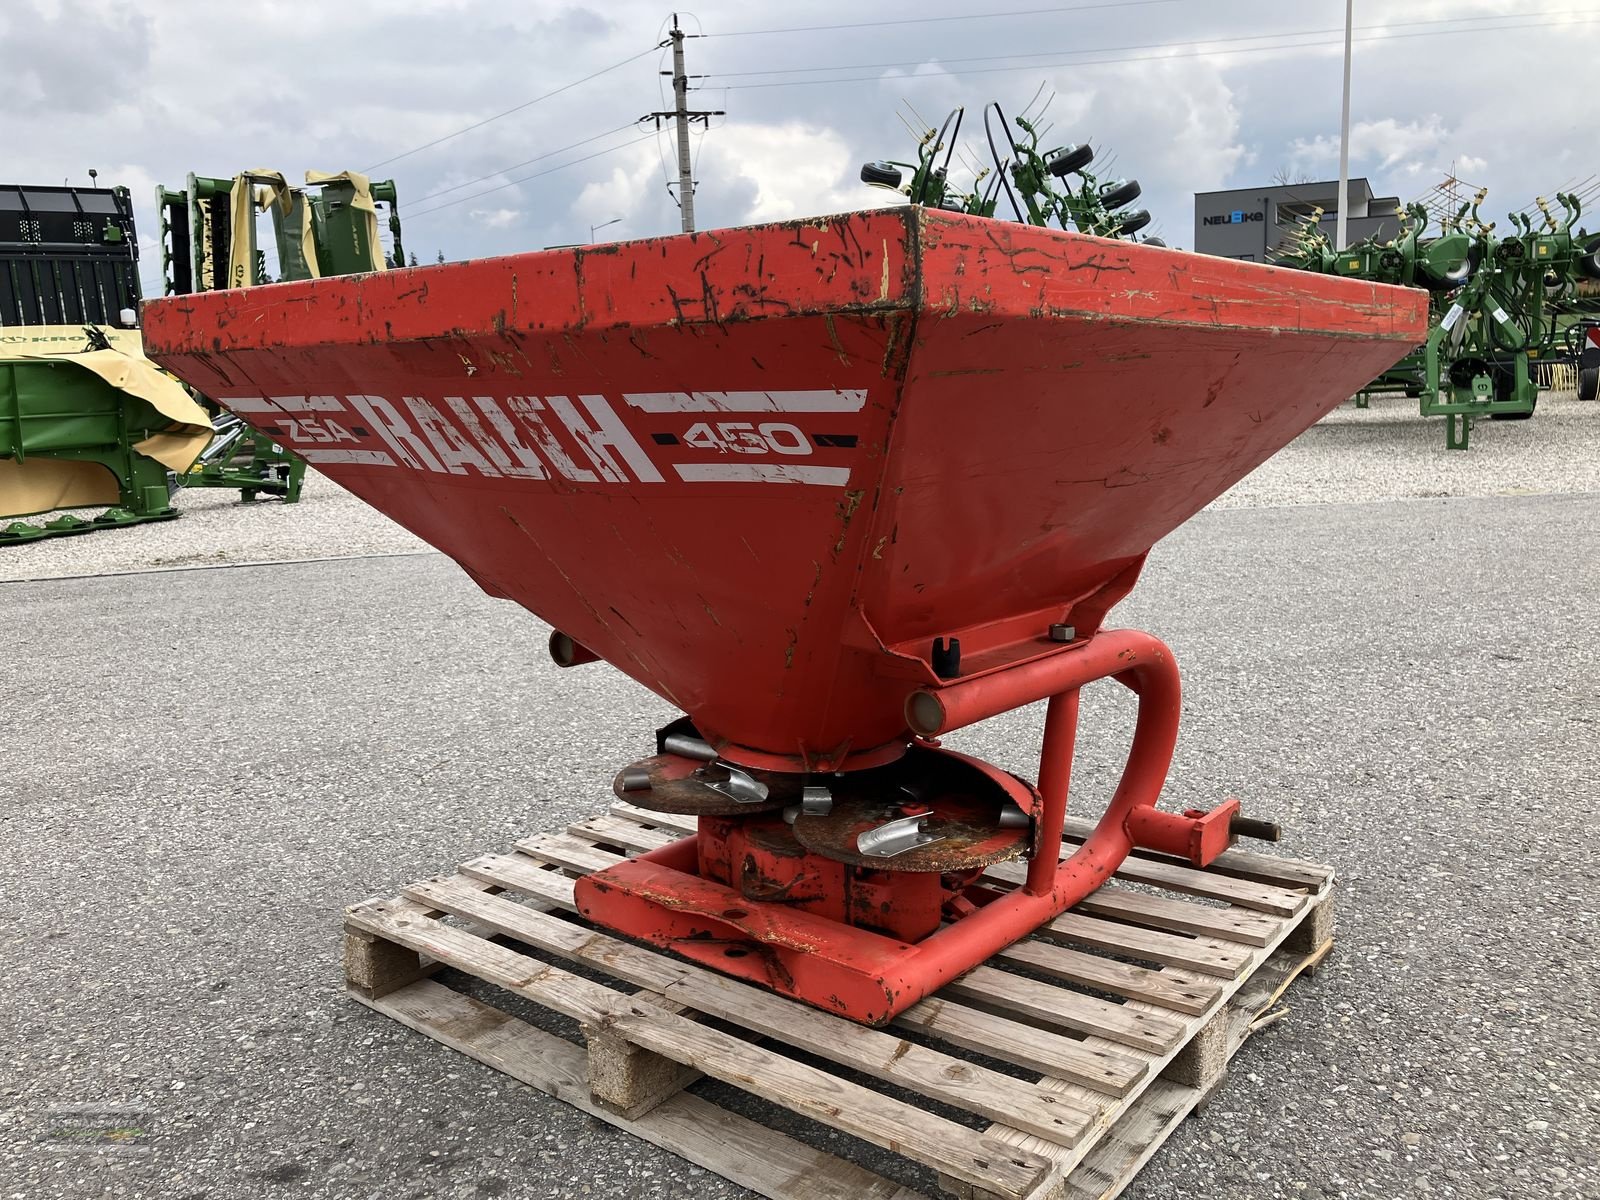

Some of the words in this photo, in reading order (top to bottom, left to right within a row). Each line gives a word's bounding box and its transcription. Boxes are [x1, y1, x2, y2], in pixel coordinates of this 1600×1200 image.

[31, 335, 120, 343] KROE
[274, 418, 361, 443] ZSA
[345, 394, 667, 483] RAUCH
[682, 422, 813, 455] 450
